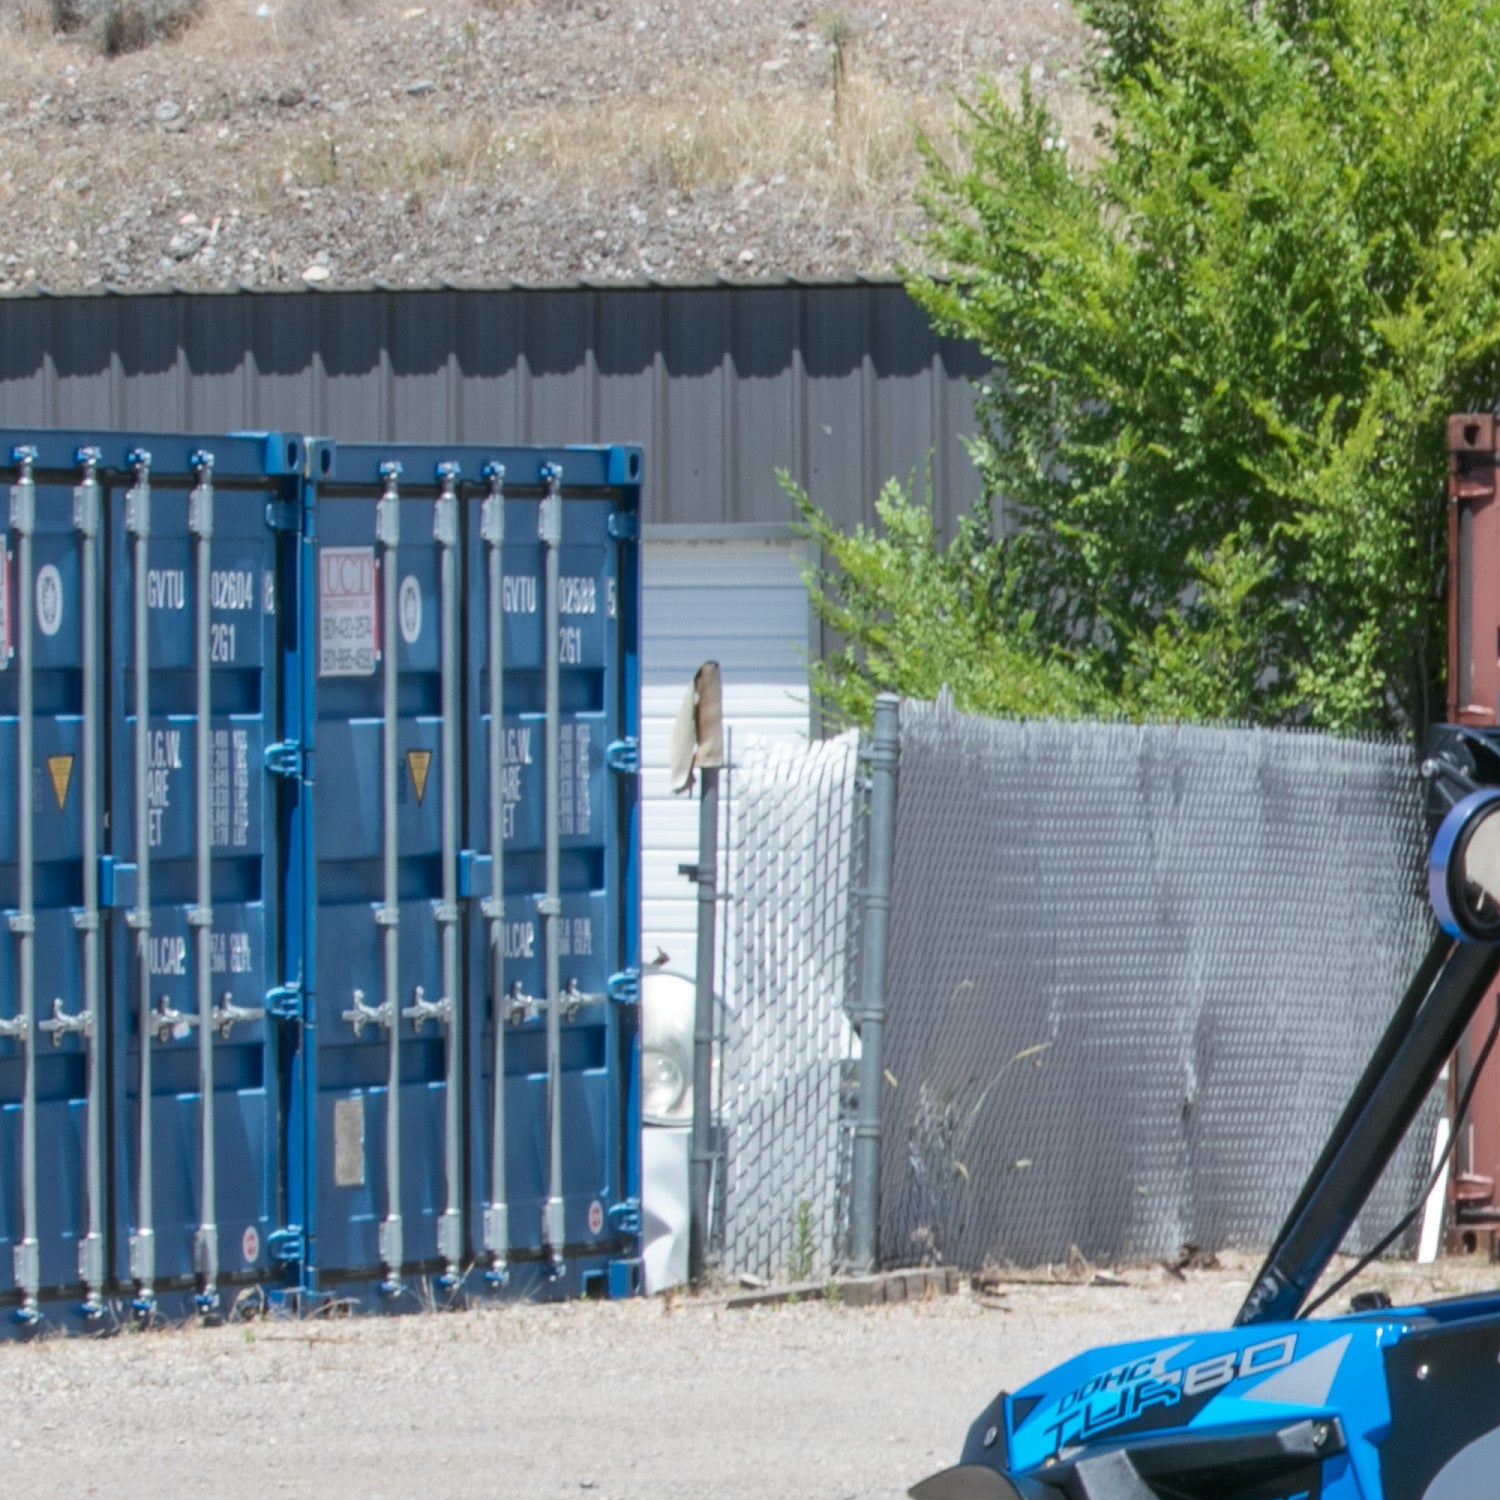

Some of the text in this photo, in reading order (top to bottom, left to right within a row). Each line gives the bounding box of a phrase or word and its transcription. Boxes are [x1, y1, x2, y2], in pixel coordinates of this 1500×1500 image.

[147, 570, 184, 609] GVTU
[211, 571, 253, 609] 02604
[503, 575, 535, 613] GVTU
[211, 623, 235, 662] 2G1
[559, 627, 581, 663] 2G1
[147, 770, 169, 807] ARE
[149, 808, 162, 845] ET
[502, 803, 515, 838] ET
[1042, 1333, 1298, 1453] TURBO
